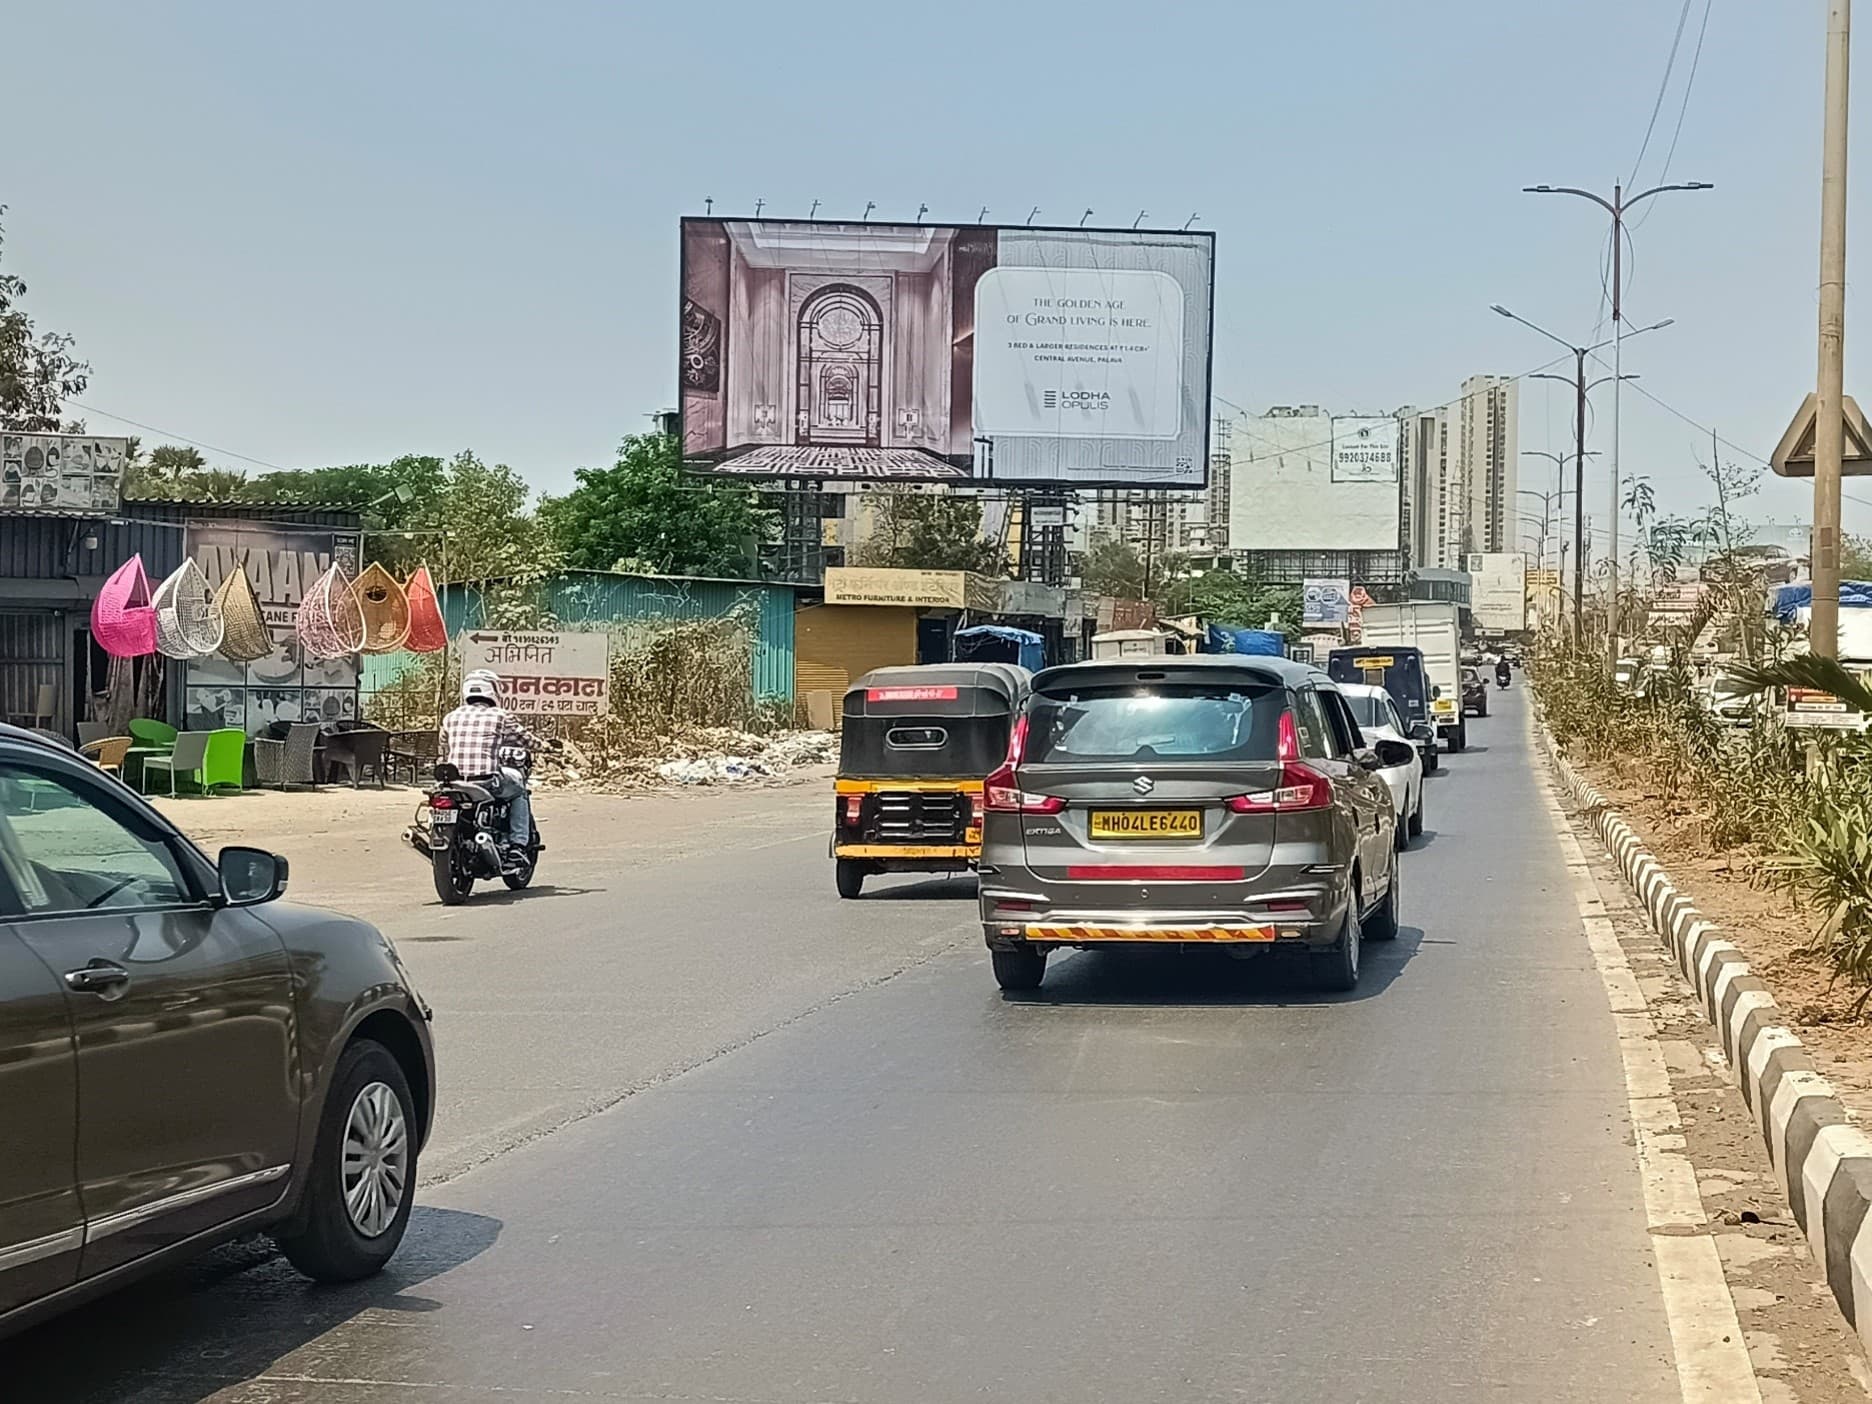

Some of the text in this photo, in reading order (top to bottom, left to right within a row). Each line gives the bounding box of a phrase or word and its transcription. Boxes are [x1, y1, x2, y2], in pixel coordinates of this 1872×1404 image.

[1034, 298, 1125, 310] THE GOLDEN AGE
[1007, 314, 1020, 324] OF
[1070, 316, 1105, 327] LIVING
[1109, 317, 1118, 327] IS
[1035, 342, 1063, 350] LARGER
[1064, 343, 1108, 351] RESIDENCES
[1062, 391, 1111, 400] LODHA
[1061, 400, 1109, 410] OPULIS
[1102, 814, 1198, 831] MH04LE6440
